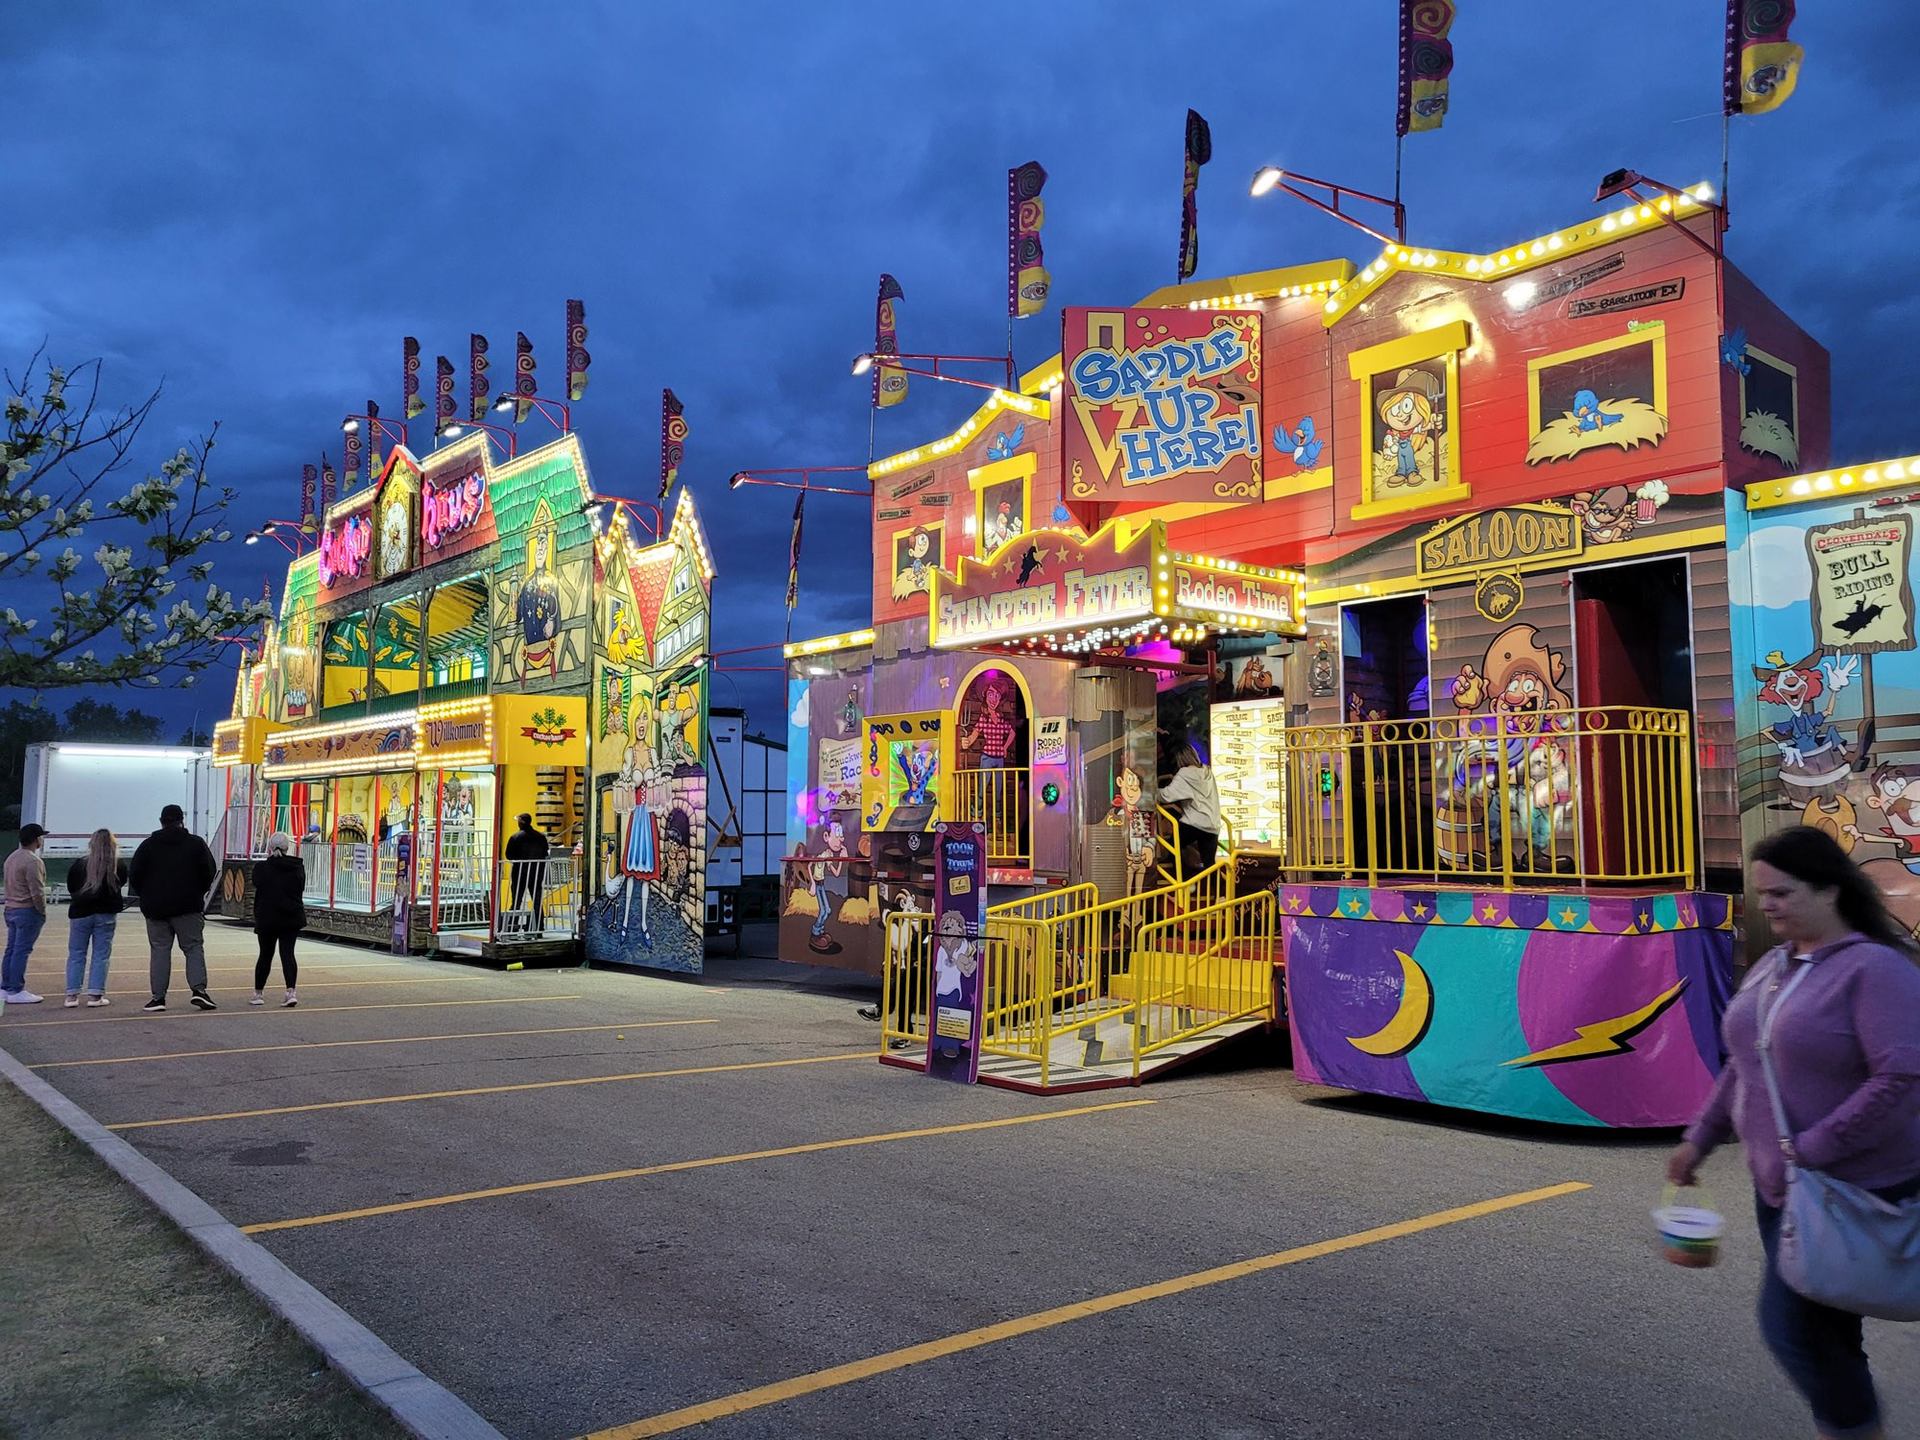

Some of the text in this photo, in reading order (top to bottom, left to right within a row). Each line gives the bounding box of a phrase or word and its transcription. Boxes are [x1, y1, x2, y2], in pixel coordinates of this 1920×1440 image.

[1660, 284, 1678, 298] EX
[1072, 329, 1244, 401] SADDLE
[1143, 384, 1216, 435] UP
[1120, 408, 1260, 481] HERE!
[1424, 511, 1571, 570] SALOON
[1817, 527, 1900, 550] CLOVERDALE
[1827, 549, 1889, 580] BULL
[1175, 568, 1291, 621] Rodeo Time
[1833, 572, 1894, 599] RIDING
[938, 565, 1153, 640] STAMPEDE FEVER
[425, 719, 484, 747] Willkommen
[1037, 737, 1062, 750] RODEO
[829, 751, 862, 769] Chuckw
[945, 842, 974, 855] TOON
[946, 858, 975, 871] TOWN
